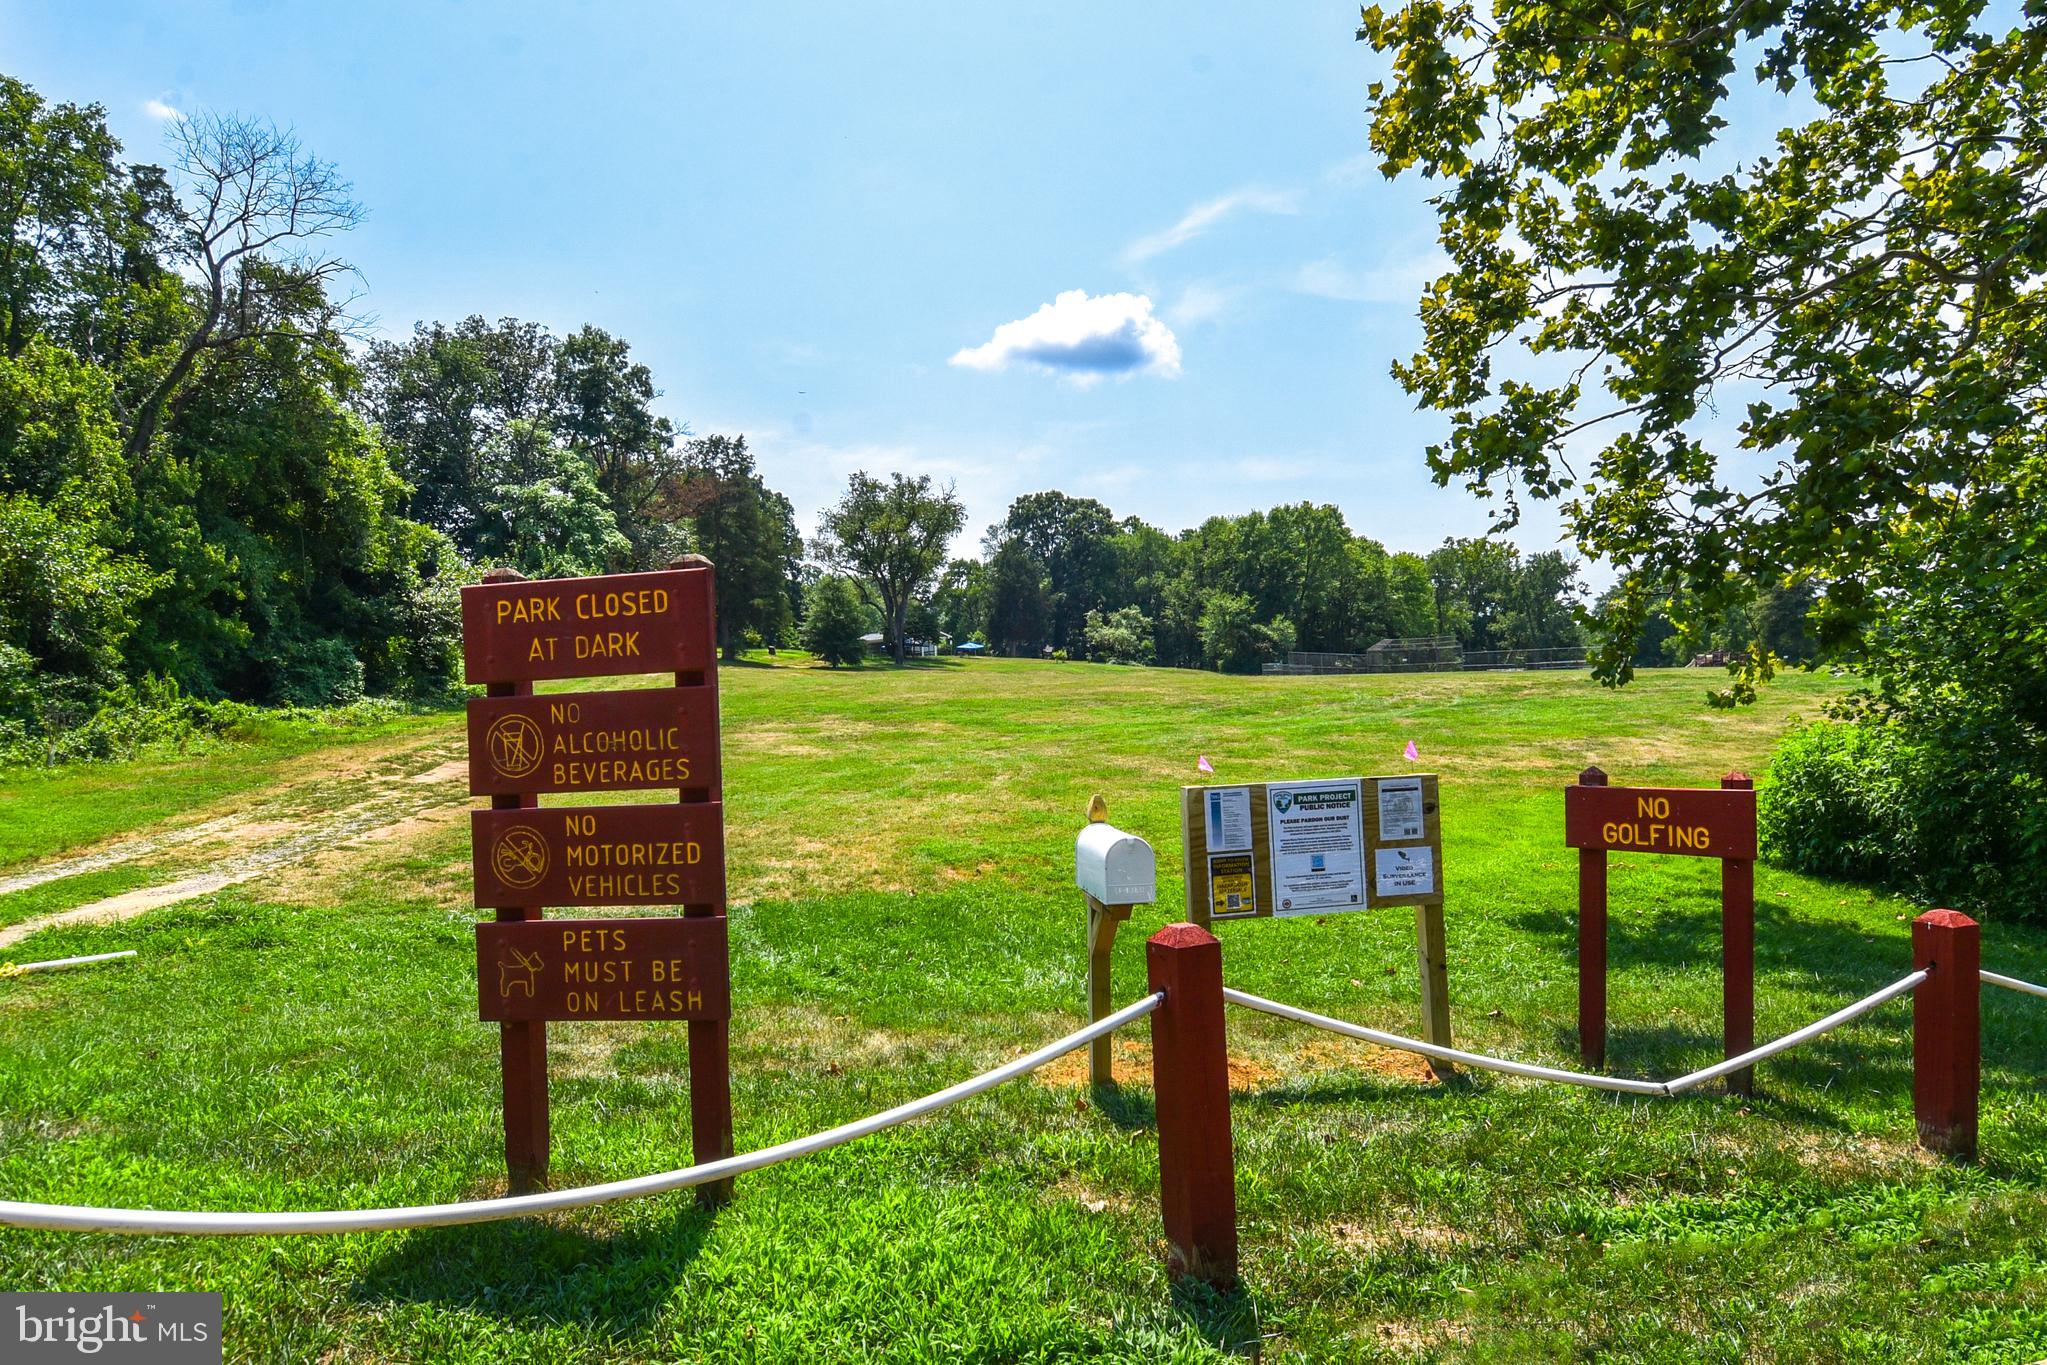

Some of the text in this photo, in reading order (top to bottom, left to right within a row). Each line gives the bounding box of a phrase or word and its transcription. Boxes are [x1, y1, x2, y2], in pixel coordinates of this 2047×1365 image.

[497, 589, 668, 625] PARK CLOSED
[528, 631, 640, 662] AT DARK
[551, 703, 580, 725] NO
[553, 727, 679, 755] ALCOHOLIC
[554, 758, 690, 785] BEVERAGES
[1300, 801, 1351, 811] PUBLIC NOTICE
[1320, 792, 1351, 800] PROJECT
[1637, 797, 1670, 819] NO
[565, 814, 596, 837] NO
[1603, 822, 1710, 849] GOLFING
[567, 842, 701, 867] MOTORIZED
[568, 873, 680, 897] VEHICLES
[1382, 872, 1427, 880] SURVEILLANCE
[563, 929, 626, 952] PETS
[564, 959, 682, 983] MUST BE
[567, 990, 702, 1013] ON LEASH
